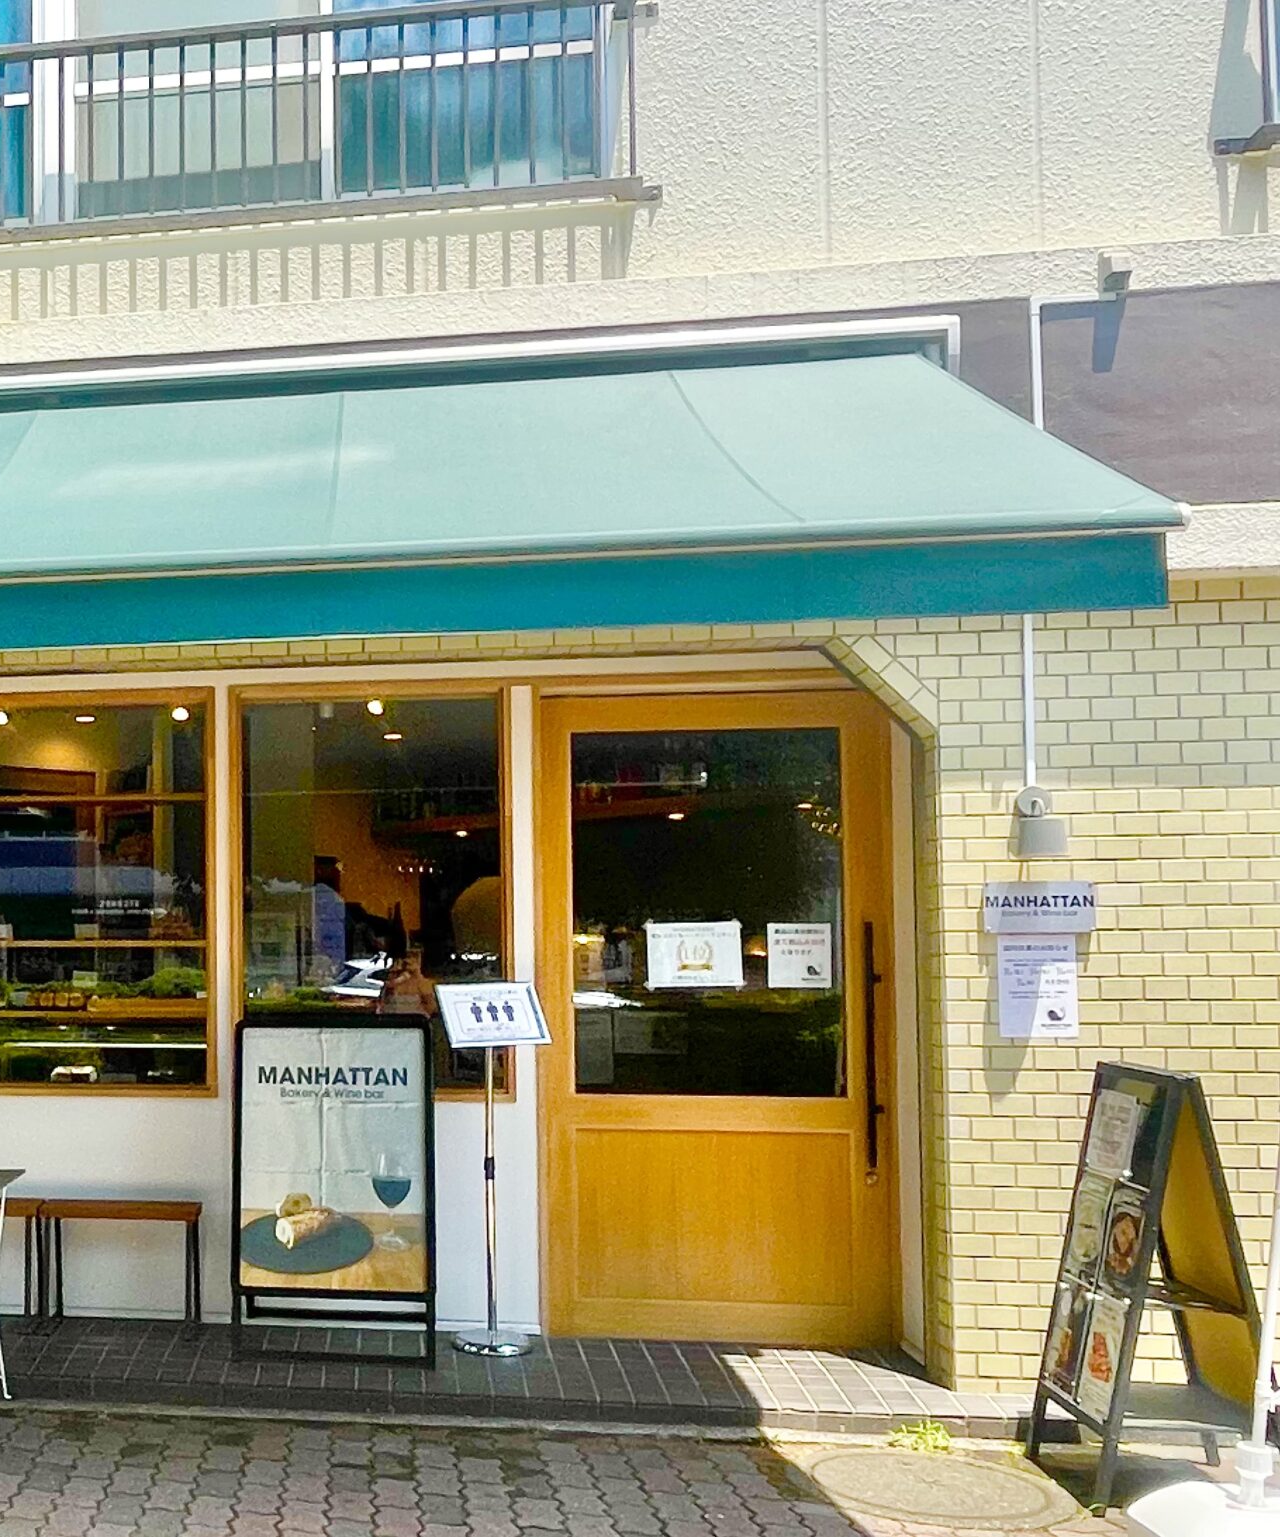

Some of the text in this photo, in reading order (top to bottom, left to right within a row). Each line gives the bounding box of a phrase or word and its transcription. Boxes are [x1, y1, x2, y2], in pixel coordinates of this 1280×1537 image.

[985, 895, 1095, 907] MANHATTAN
[258, 1065, 409, 1086] MANHATTAN
[280, 1087, 320, 1099] Bakery
[334, 1089, 362, 1098] Wine
[364, 1089, 385, 1099] bar
